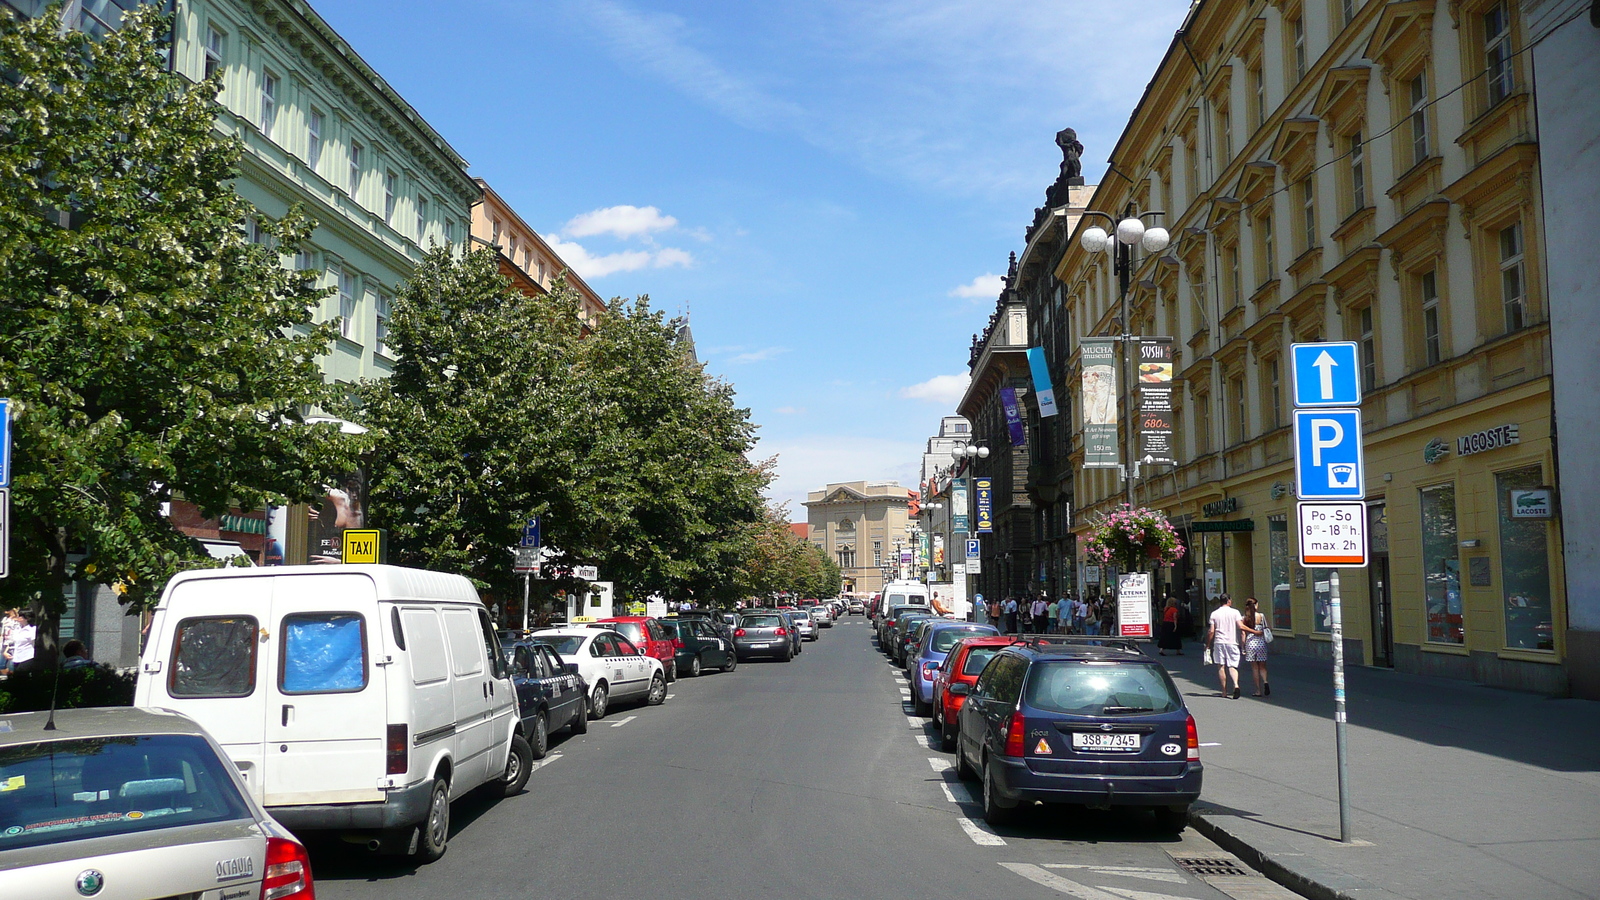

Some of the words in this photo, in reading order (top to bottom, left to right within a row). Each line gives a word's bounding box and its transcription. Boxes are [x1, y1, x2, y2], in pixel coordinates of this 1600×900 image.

[1082, 346, 1113, 354] MUCHA
[1144, 419, 1162, 428] 680
[1310, 418, 1344, 467] P
[1456, 424, 1513, 456] LACOSTE
[1311, 510, 1326, 521] Po
[1192, 520, 1254, 530] SALAMANDER
[349, 540, 373, 555] TAXI
[968, 541, 977, 552] P
[1343, 540, 1357, 550] 2h
[1082, 734, 1101, 745] 3S8
[1109, 734, 1135, 746] 7345
[1164, 745, 1177, 753] CZ
